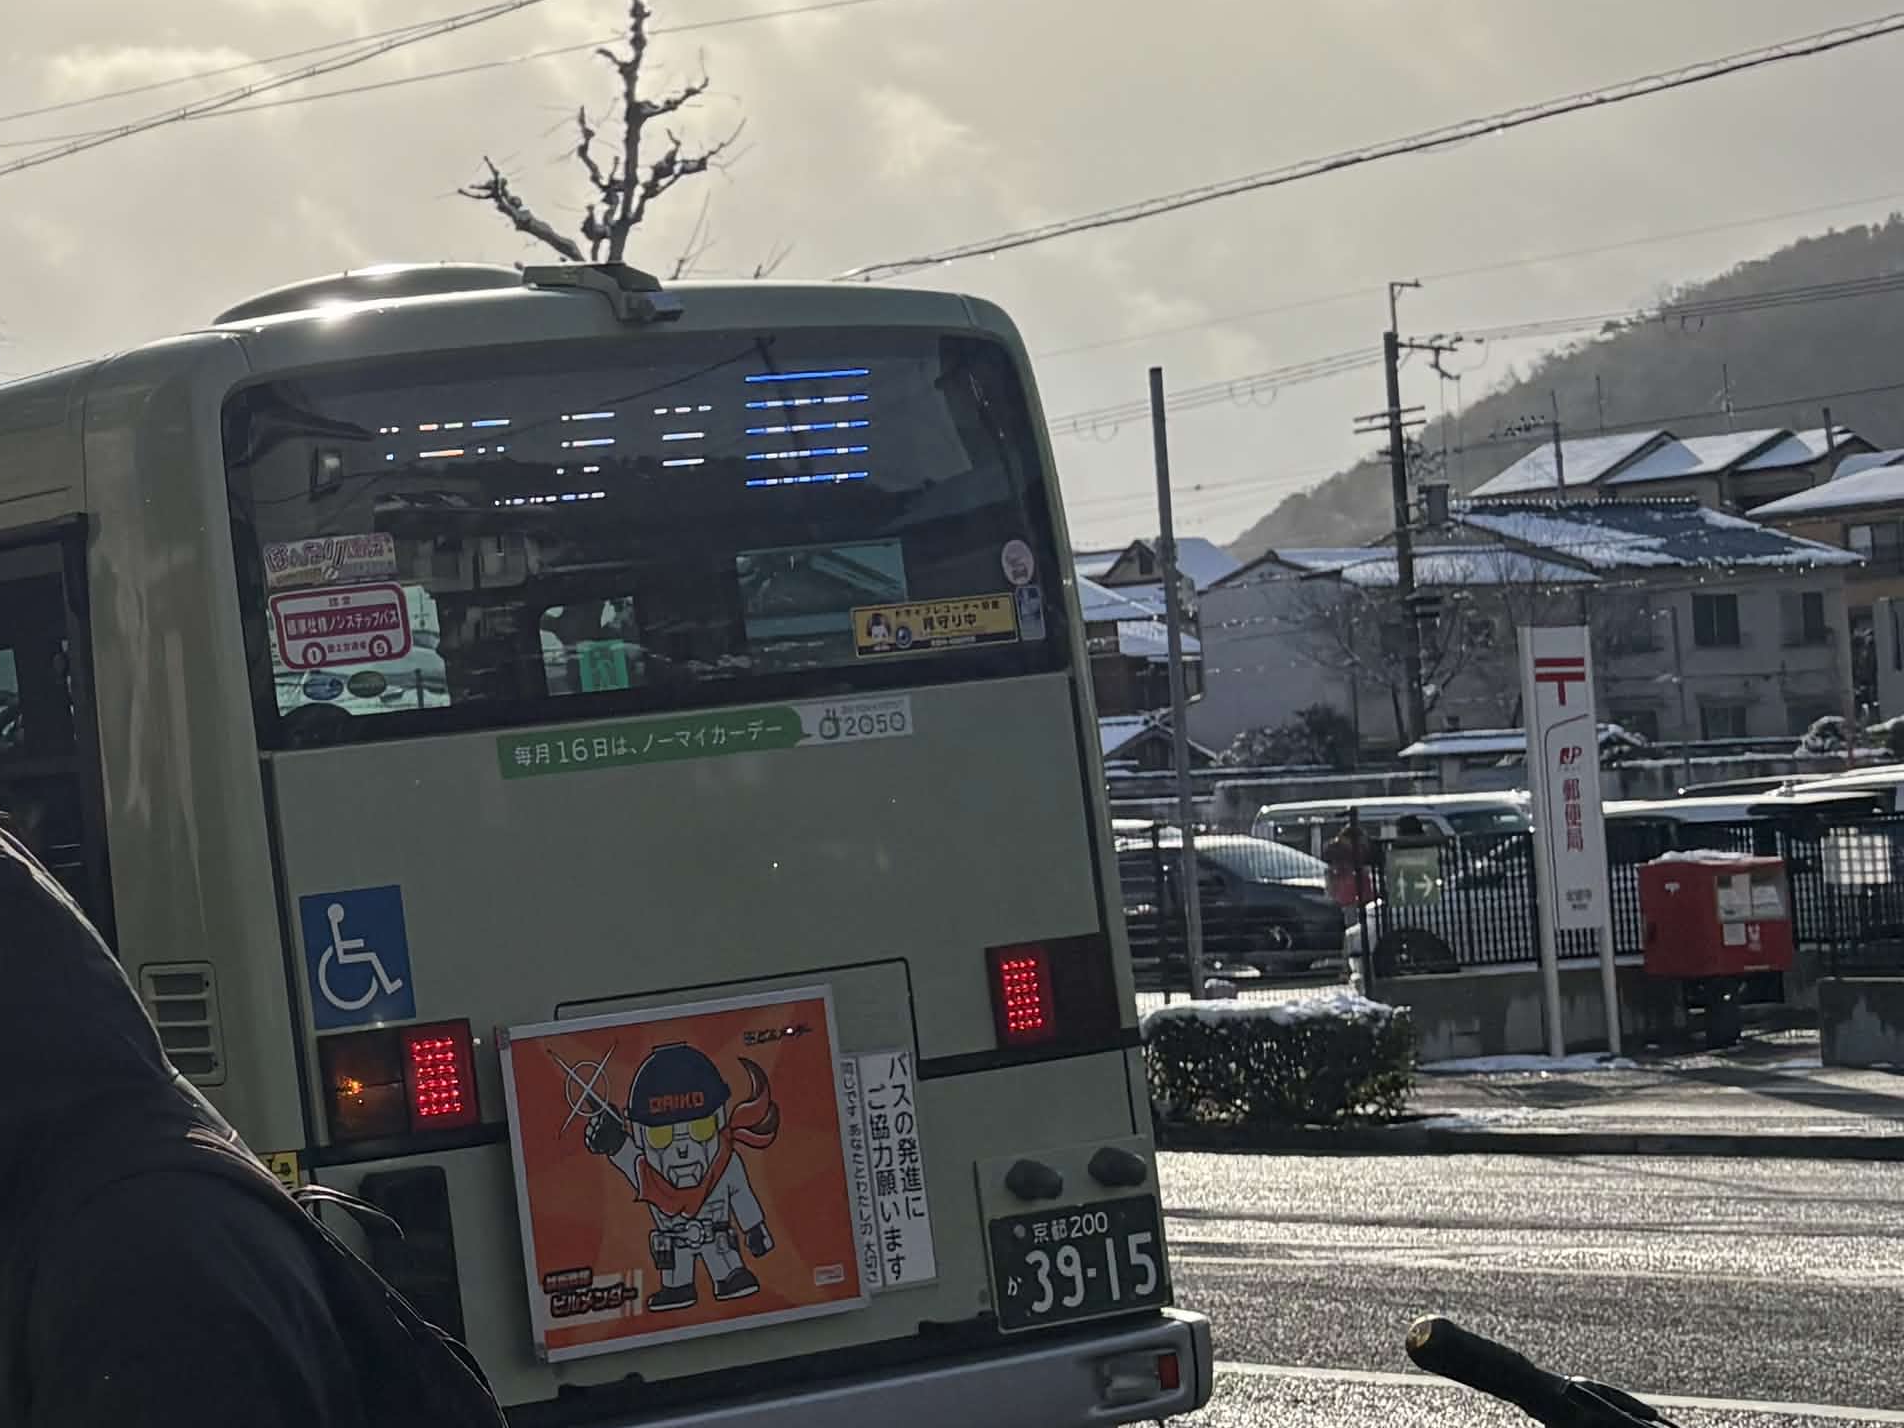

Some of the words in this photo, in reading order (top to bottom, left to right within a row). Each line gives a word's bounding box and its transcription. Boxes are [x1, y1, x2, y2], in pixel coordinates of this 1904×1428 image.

[1562, 778, 1584, 853] 郵便局
[867, 1083, 906, 1282] ご協力願います
[888, 1051, 926, 1221] バスの発進に
[1024, 1231, 1158, 1314] 39-15
